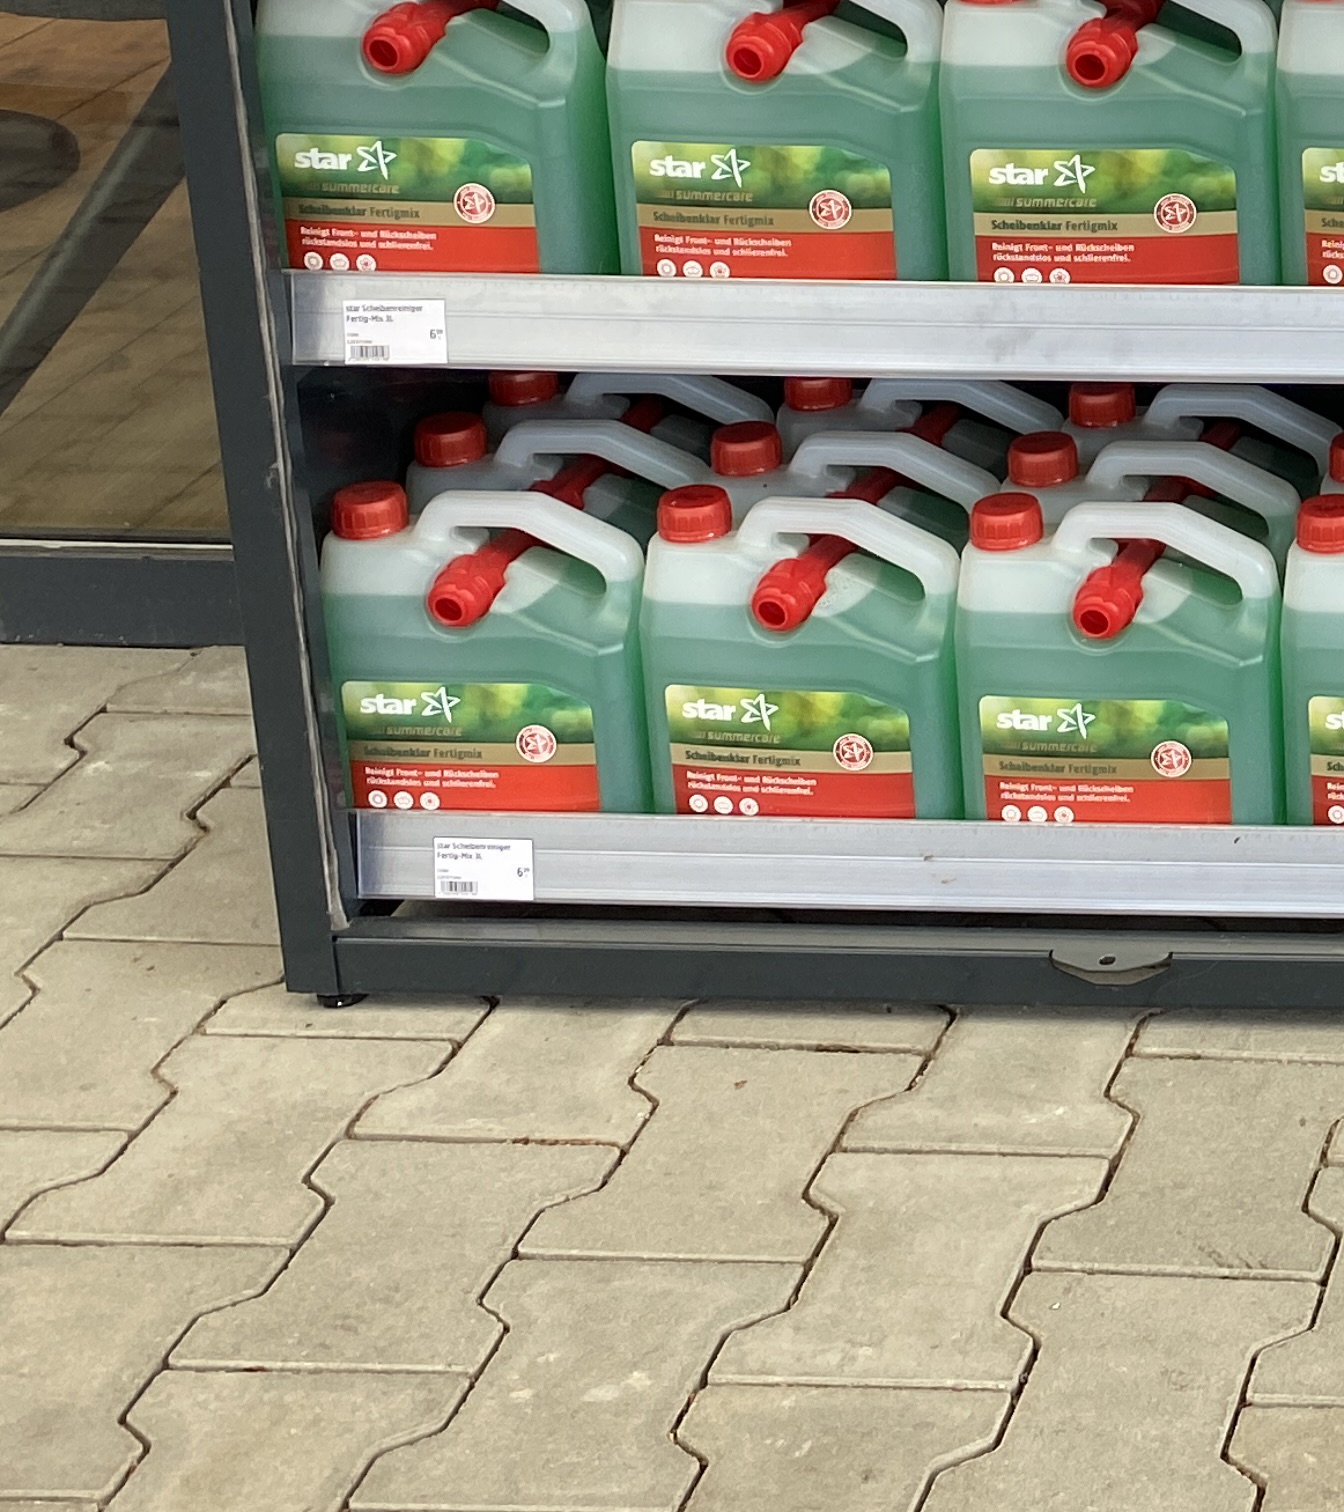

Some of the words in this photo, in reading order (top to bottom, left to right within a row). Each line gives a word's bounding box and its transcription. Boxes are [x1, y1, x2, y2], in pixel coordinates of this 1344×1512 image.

[294, 147, 352, 171] star
[650, 155, 706, 178] star
[989, 162, 1048, 185] star
[675, 191, 754, 203] summercare
[369, 207, 420, 220] Fertigmix
[723, 214, 774, 227] Fertigmix
[991, 219, 1062, 231] Scheibenklar
[1065, 221, 1118, 233] Fertigmix
[360, 693, 416, 715] star
[681, 699, 736, 721] star
[996, 709, 1052, 731] star
[433, 748, 482, 760] Fertigmix
[1068, 762, 1117, 775] Fertigmix
